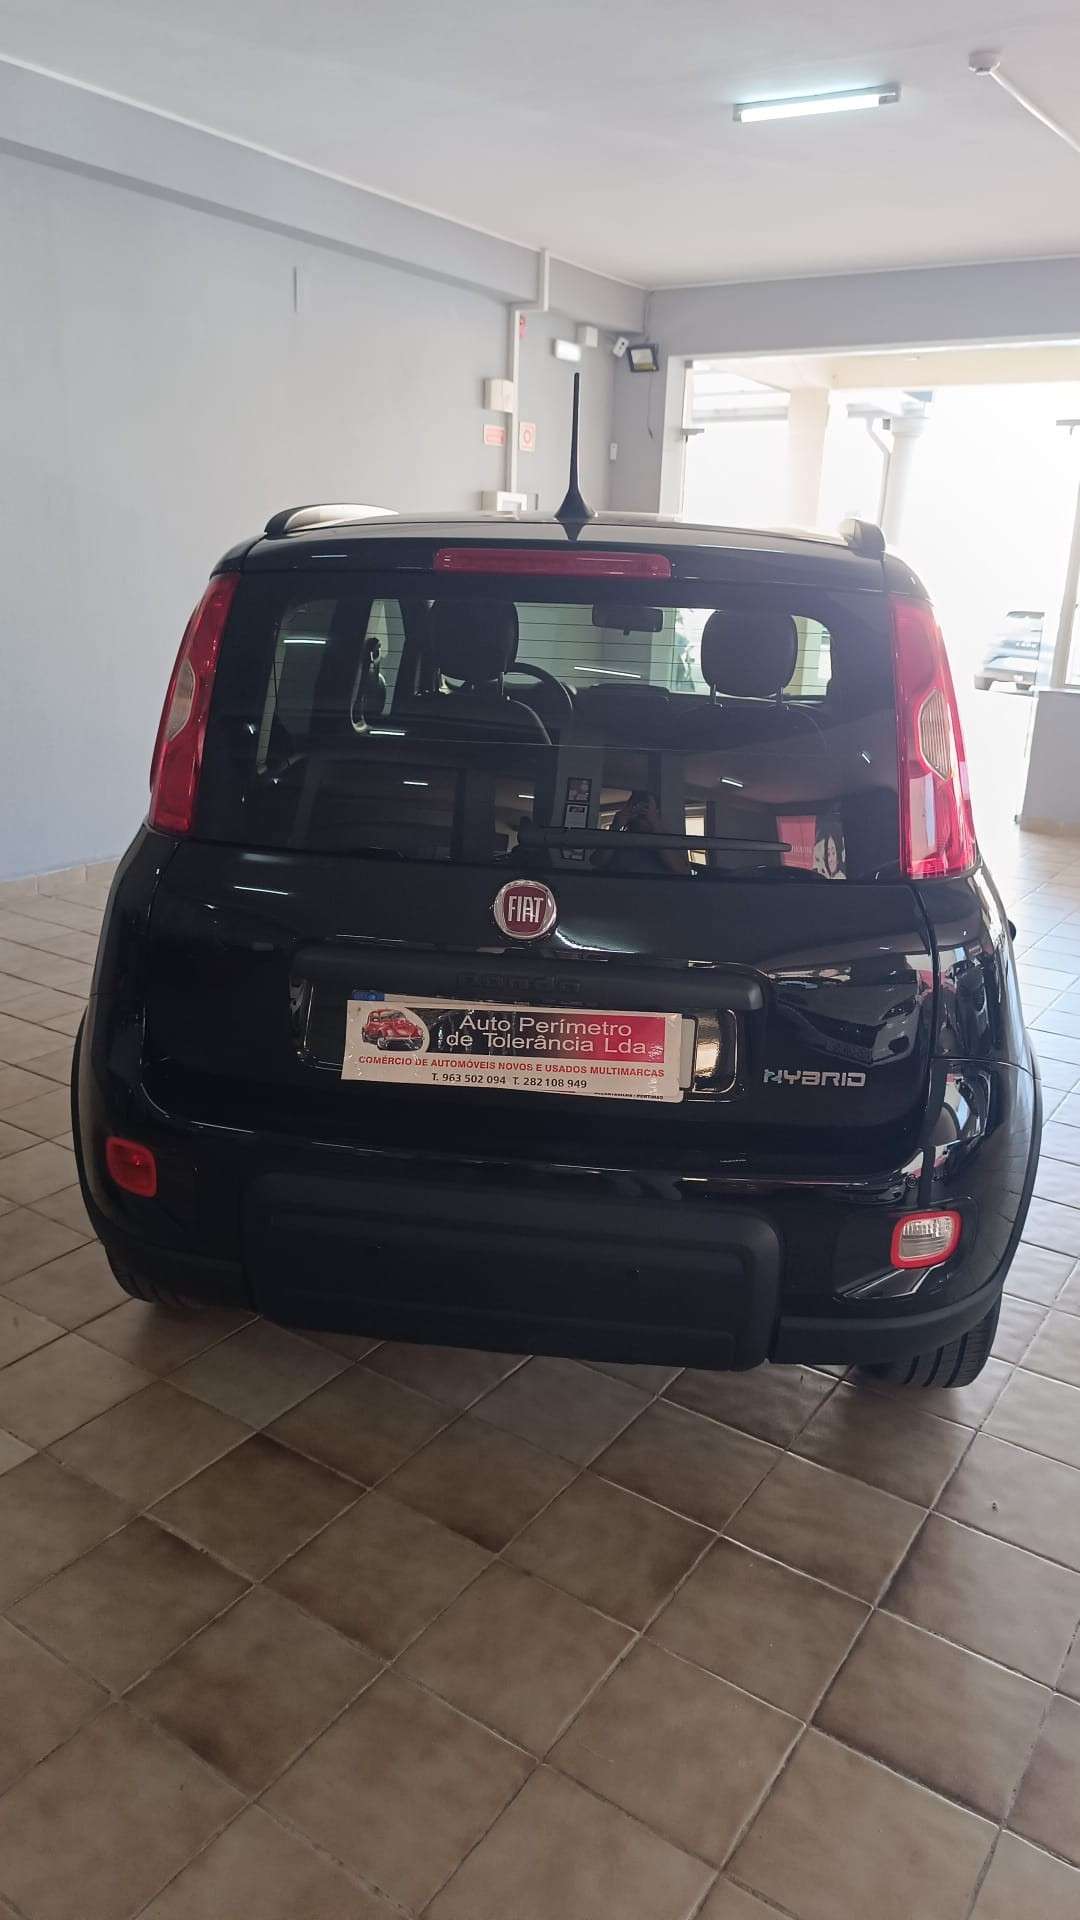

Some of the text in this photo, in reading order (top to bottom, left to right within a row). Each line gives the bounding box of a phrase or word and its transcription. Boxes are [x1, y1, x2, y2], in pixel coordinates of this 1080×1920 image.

[508, 896, 544, 923] FIAT
[459, 1014, 632, 1037] Auto Perímetro
[446, 1031, 474, 1047] de
[483, 1032, 594, 1052] Tolerância
[358, 1056, 412, 1067] COMÉRCIO
[416, 1058, 429, 1067] DE
[431, 1058, 496, 1070] AUTOMÓVEIS
[498, 1062, 534, 1071] NOVOS
[545, 1064, 587, 1074] USADOS
[590, 1066, 664, 1078] MULTIMARCAS
[431, 1073, 587, 1089] T. 963 502 094 T. 282 108 949
[763, 1069, 866, 1087] HYBRID
